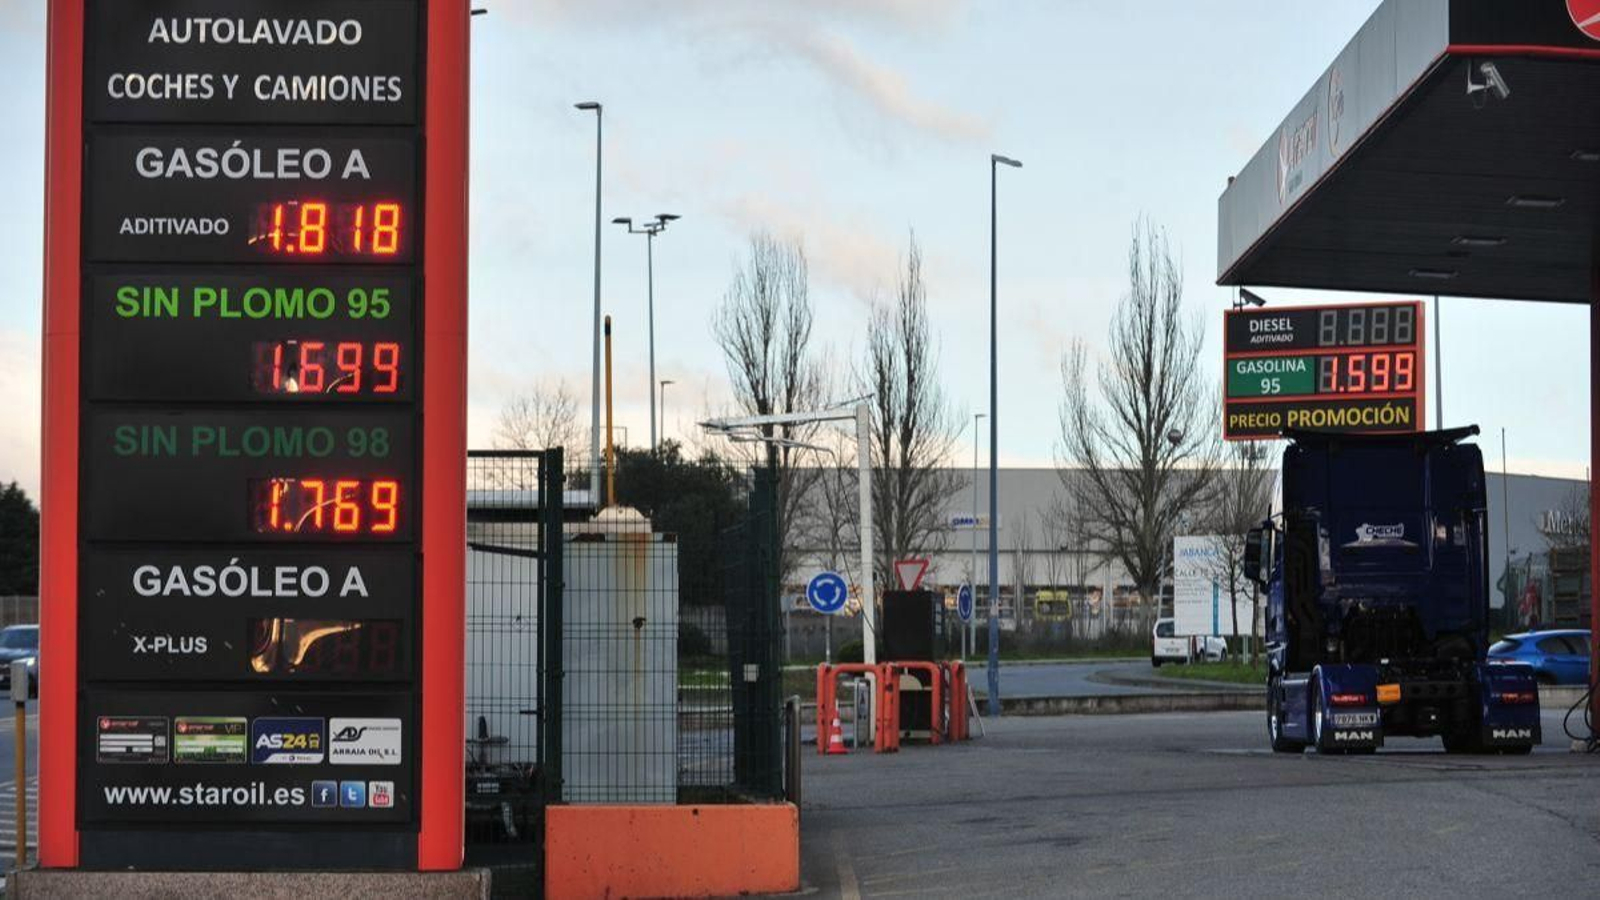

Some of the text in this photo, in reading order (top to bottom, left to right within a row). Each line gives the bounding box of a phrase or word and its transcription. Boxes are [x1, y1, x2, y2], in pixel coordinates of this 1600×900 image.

[148, 18, 363, 45] AUTOLAVADO
[107, 73, 402, 102] COCHES Y CAMIONES
[135, 140, 371, 180] GASÓLEO A
[119, 217, 230, 235] ADITIVADO
[115, 286, 391, 319] SIN PLOMO 95
[1249, 318, 1294, 333] DIESEL
[1250, 333, 1294, 344] ADITIVADO
[1236, 359, 1307, 375] GASOLINA
[1330, 353, 1414, 393] 1.599
[1260, 378, 1281, 395] 95
[1229, 402, 1410, 428] PRECIO PROMOCIÓN
[114, 425, 391, 459] SIN PLOMO 98
[269, 479, 399, 532] 1.769
[132, 558, 369, 597] GASÓLEO A
[133, 636, 208, 653] X-PLUS
[255, 733, 307, 749] AS24
[1334, 731, 1373, 741] MAN
[1492, 729, 1531, 739] MAN
[104, 782, 305, 805] www.staroil.es
